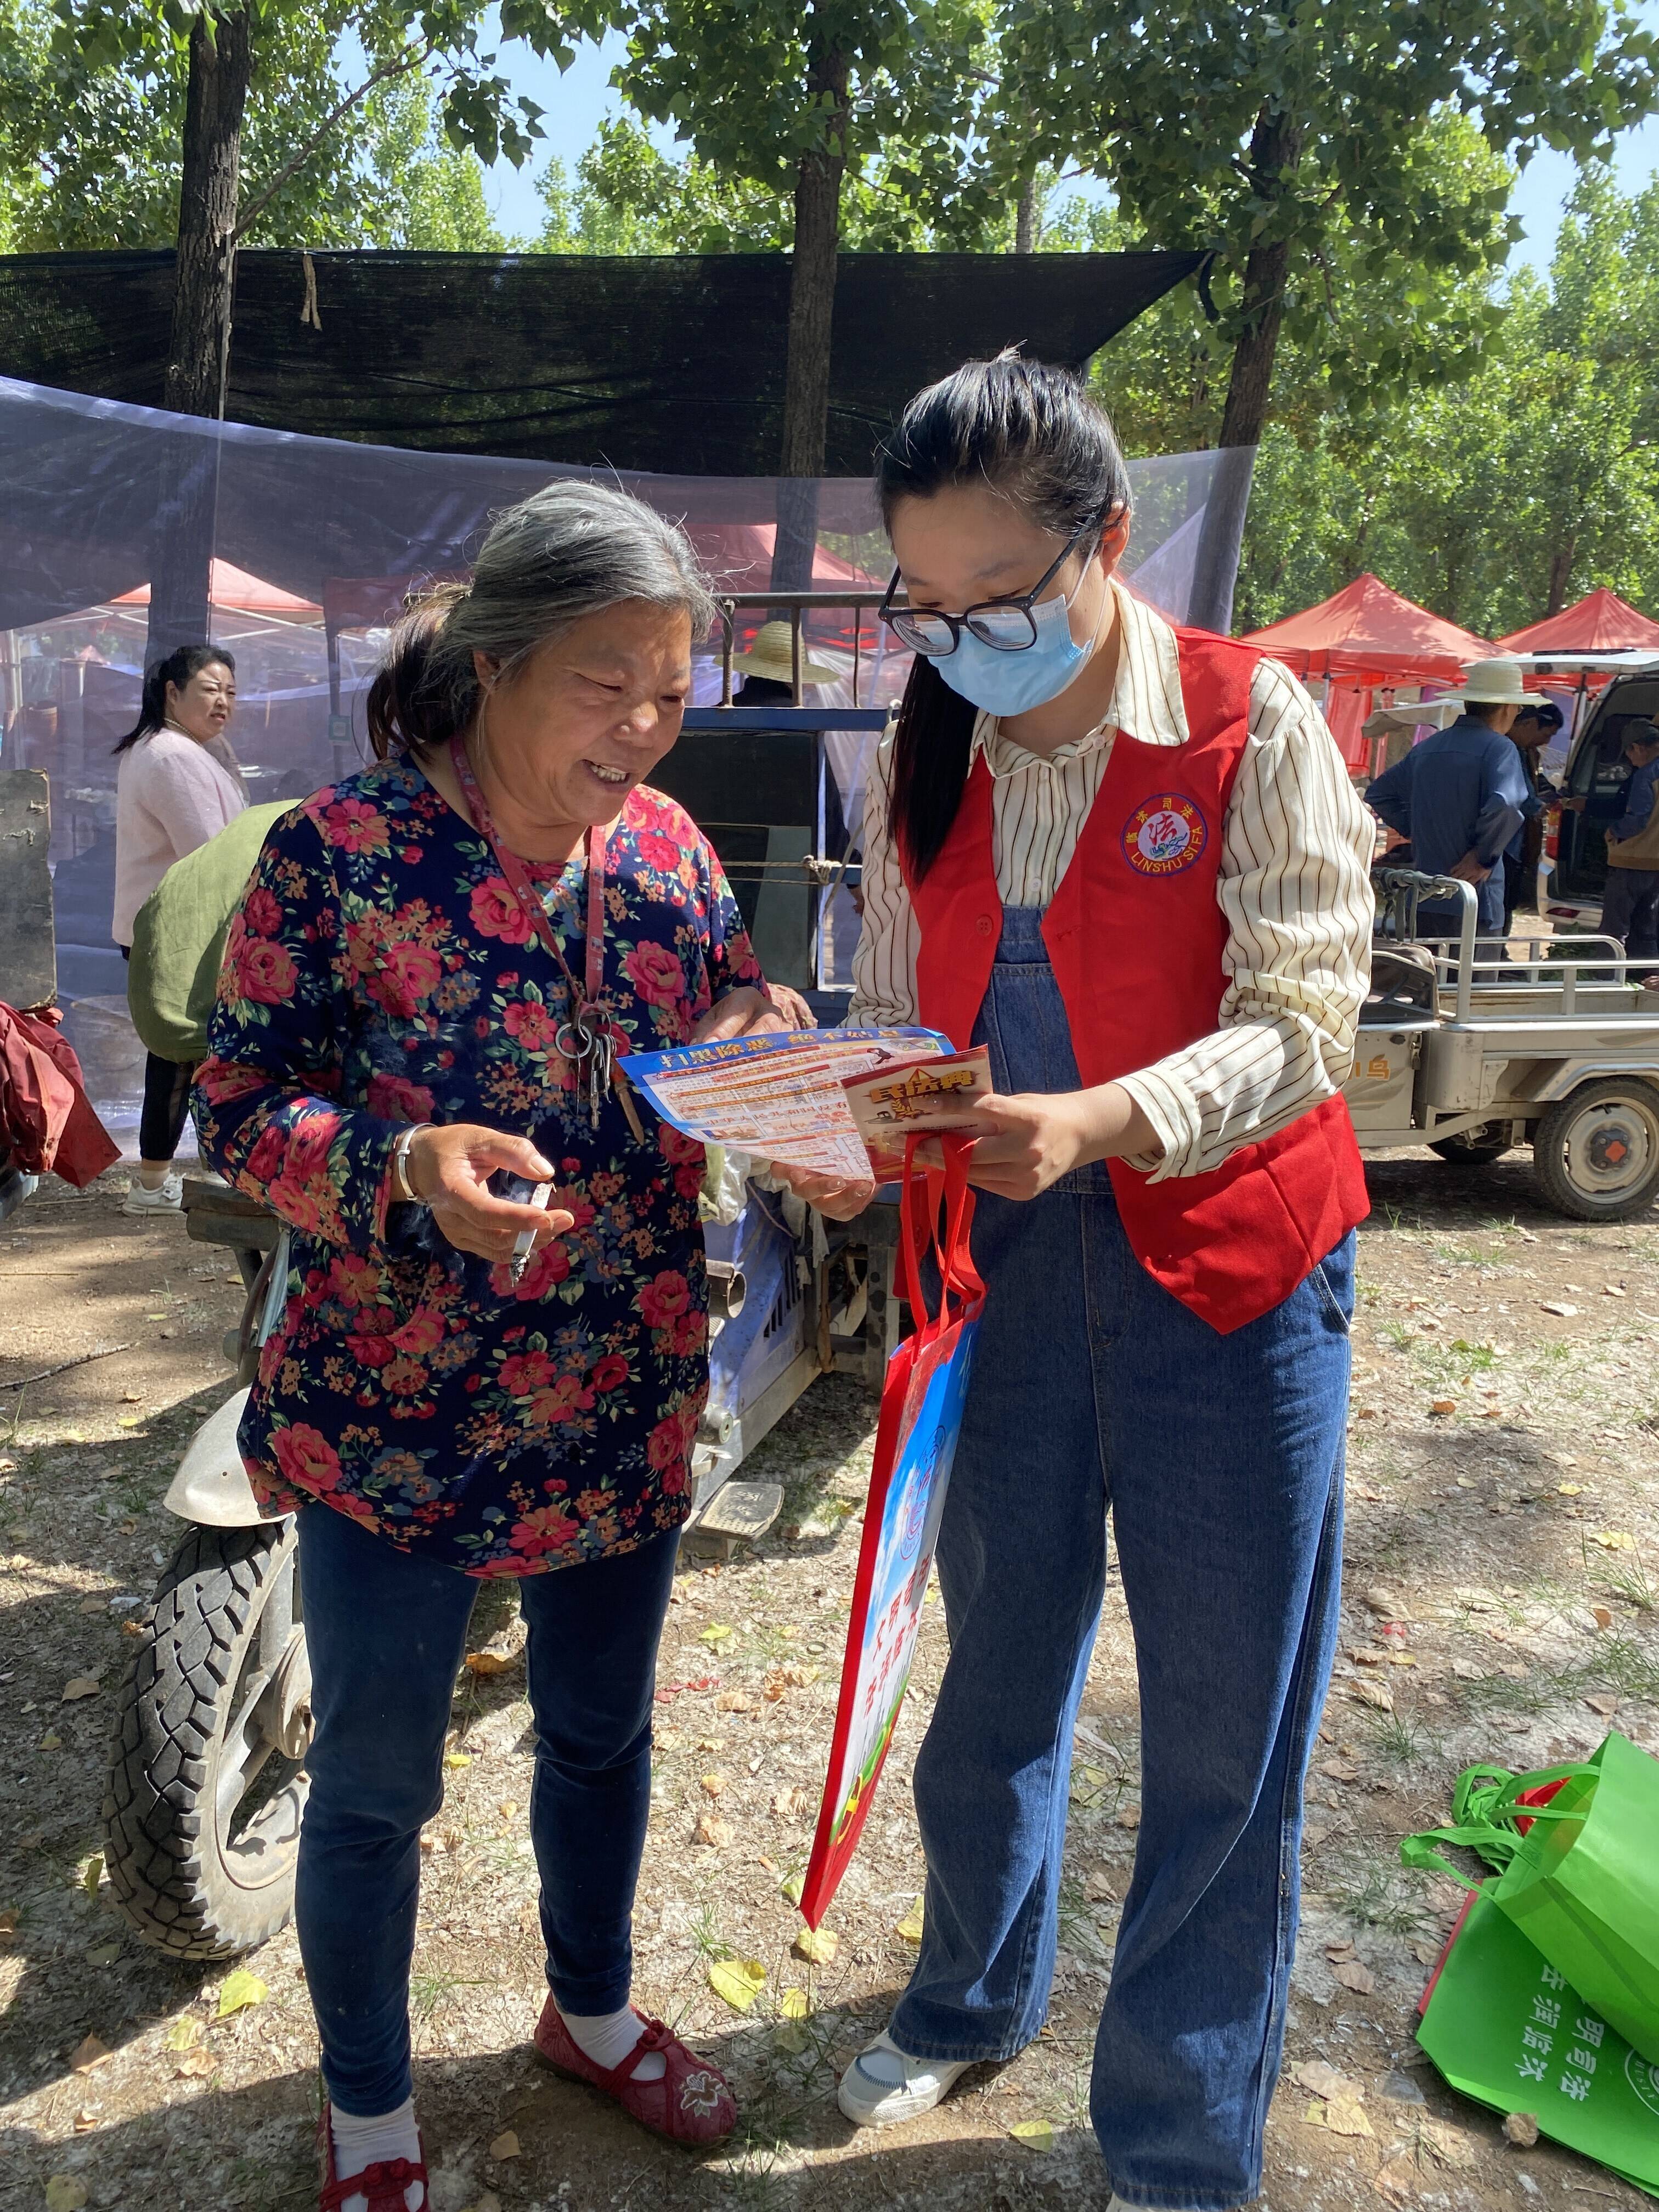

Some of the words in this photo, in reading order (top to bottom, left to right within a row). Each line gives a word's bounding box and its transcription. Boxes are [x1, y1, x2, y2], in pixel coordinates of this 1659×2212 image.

[1126, 797, 1194, 844] 临沭司法
[660, 1037, 774, 1068] 扫黑除恶
[788, 1030, 901, 1043] 绝不姑息
[870, 1069, 976, 1103] 民法典
[1560, 1997, 1606, 2102] 明司法
